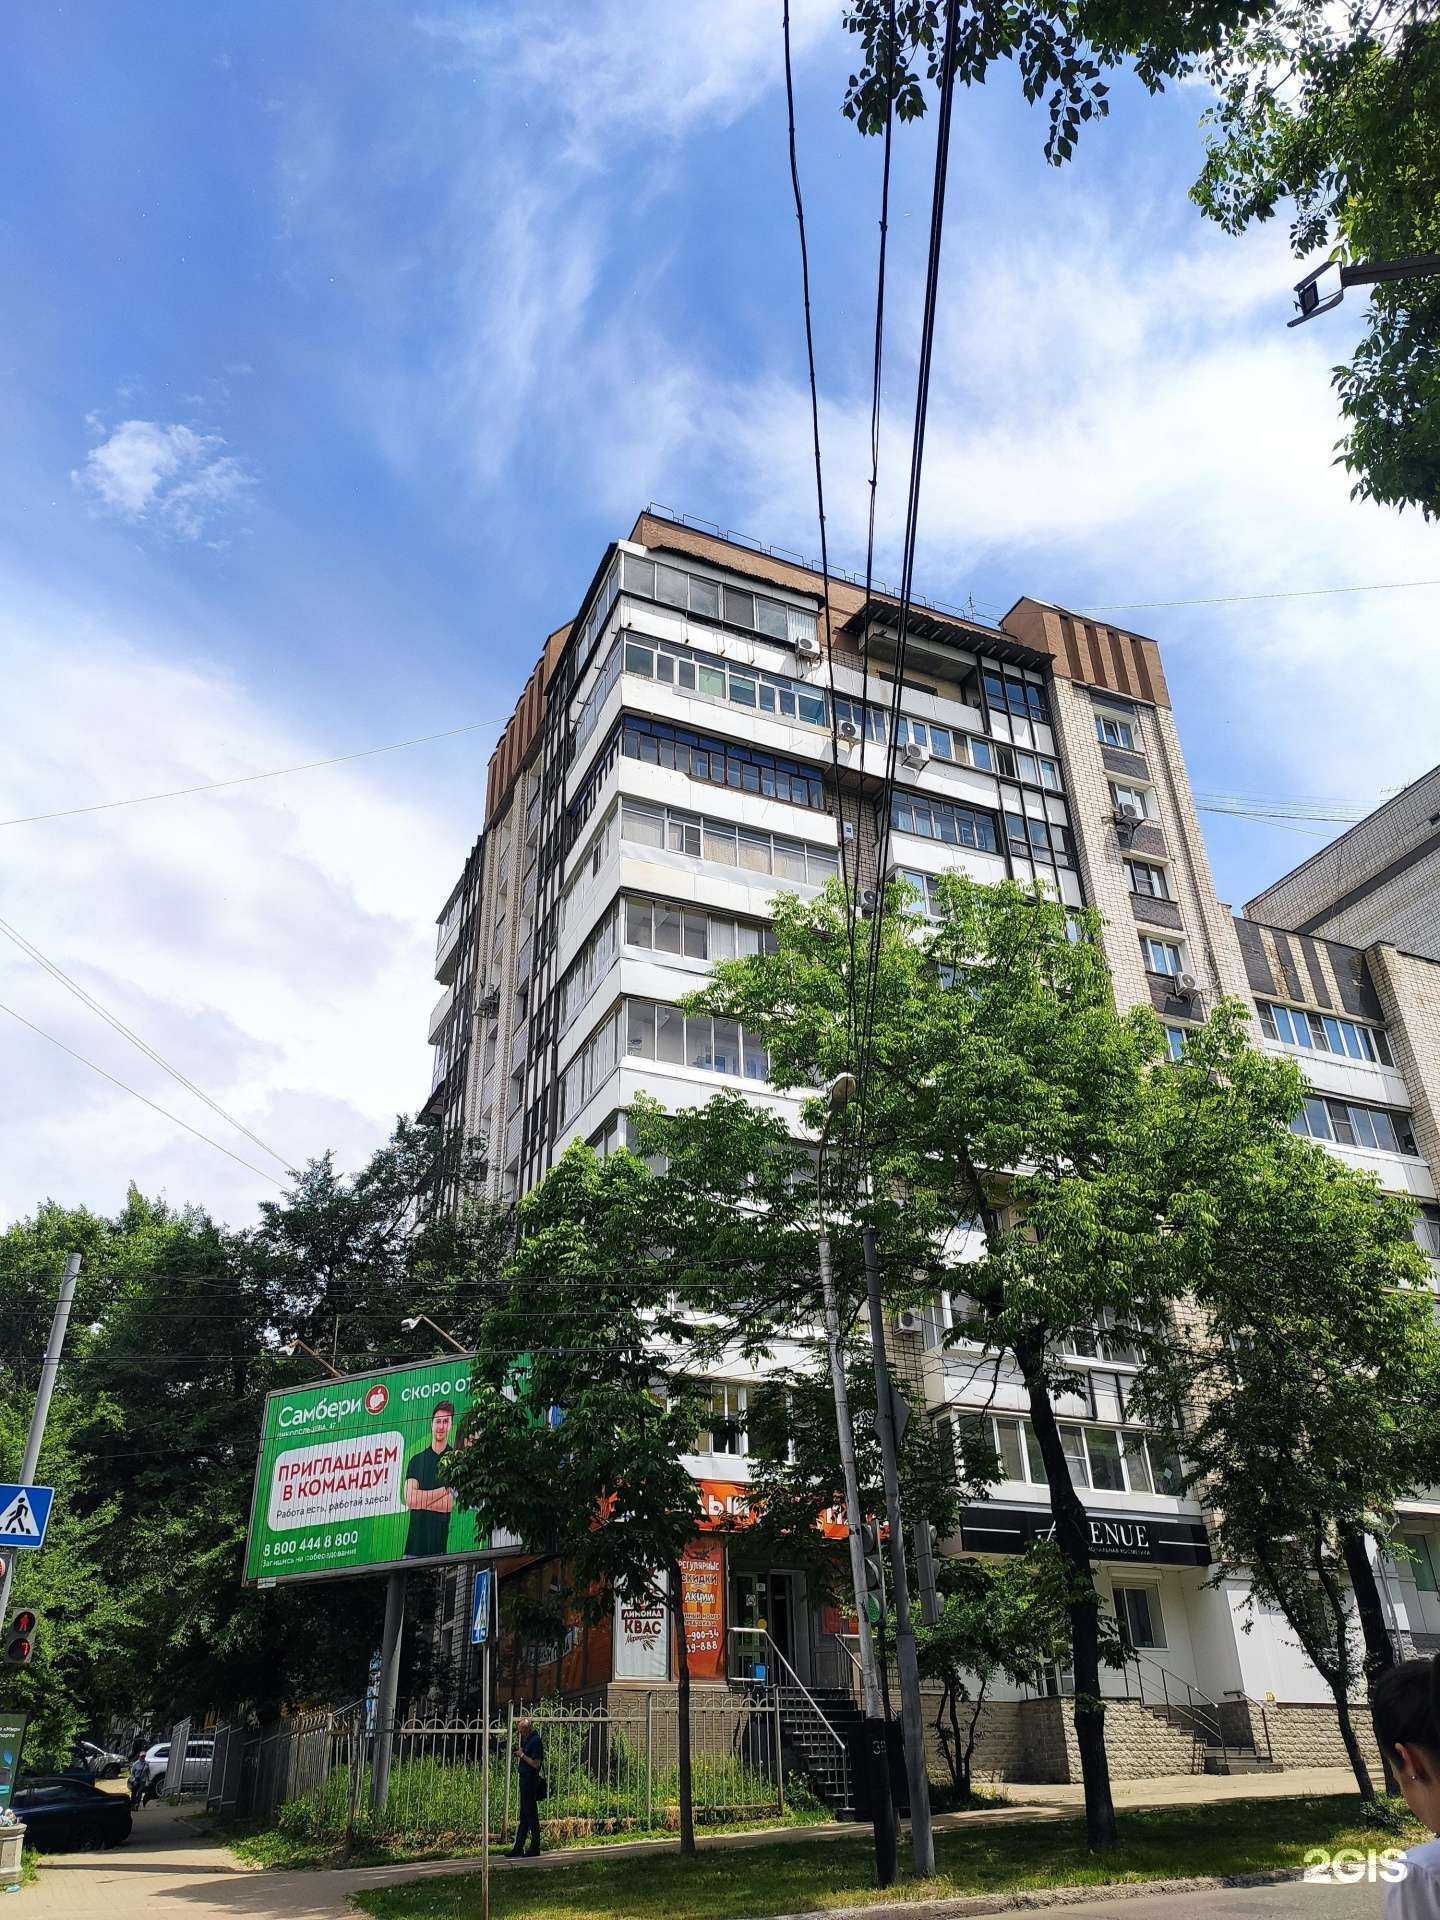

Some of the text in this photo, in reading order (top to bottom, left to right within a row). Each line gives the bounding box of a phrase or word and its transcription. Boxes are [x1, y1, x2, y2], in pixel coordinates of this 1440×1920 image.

[401, 1381, 451, 1402] СКОРО
[278, 1398, 363, 1428] Самбери
[277, 1446, 398, 1482] ПРИГЛАШАЕМ
[282, 1467, 389, 1502] В КОМАНДУ!
[276, 1507, 305, 1520] Работа
[328, 1497, 363, 1514] работай
[364, 1493, 392, 1506] здесь!
[263, 1530, 359, 1557] 8 800 444 8 800
[681, 1573, 718, 1586] СКИДКИ
[684, 1591, 716, 1604] АКЦИИ
[623, 1610, 663, 1618] ЛИМОНАД
[624, 1619, 662, 1635] КВАС
